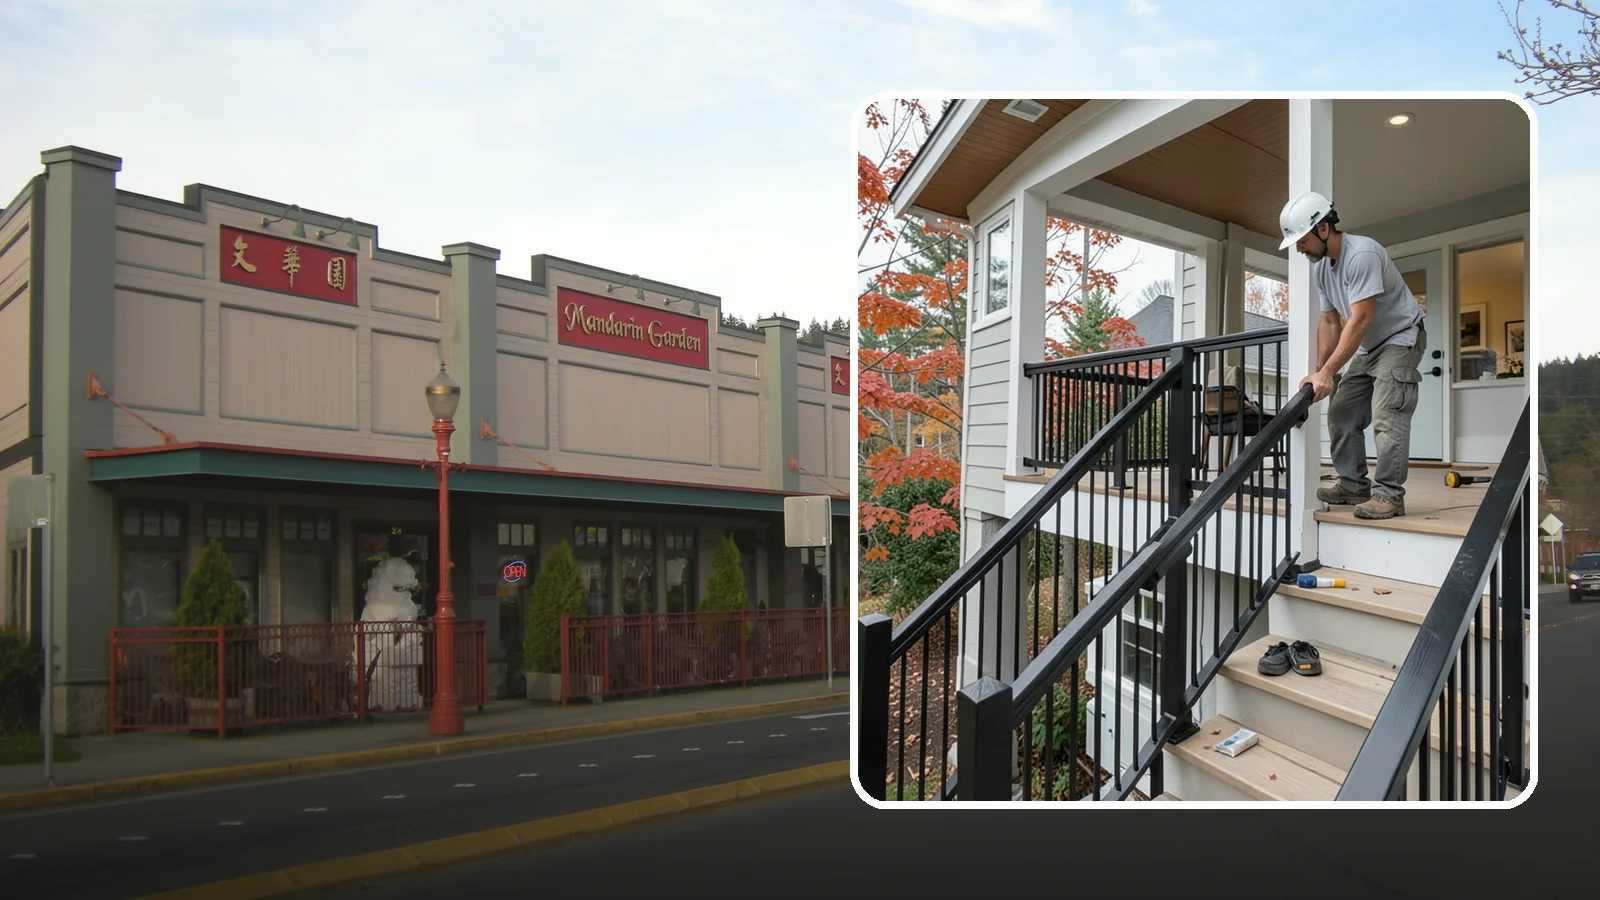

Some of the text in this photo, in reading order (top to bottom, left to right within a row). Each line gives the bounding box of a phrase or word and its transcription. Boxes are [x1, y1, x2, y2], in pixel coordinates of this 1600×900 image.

[564, 302, 701, 352] Mandarin Garden
[503, 565, 527, 578] OPEN
